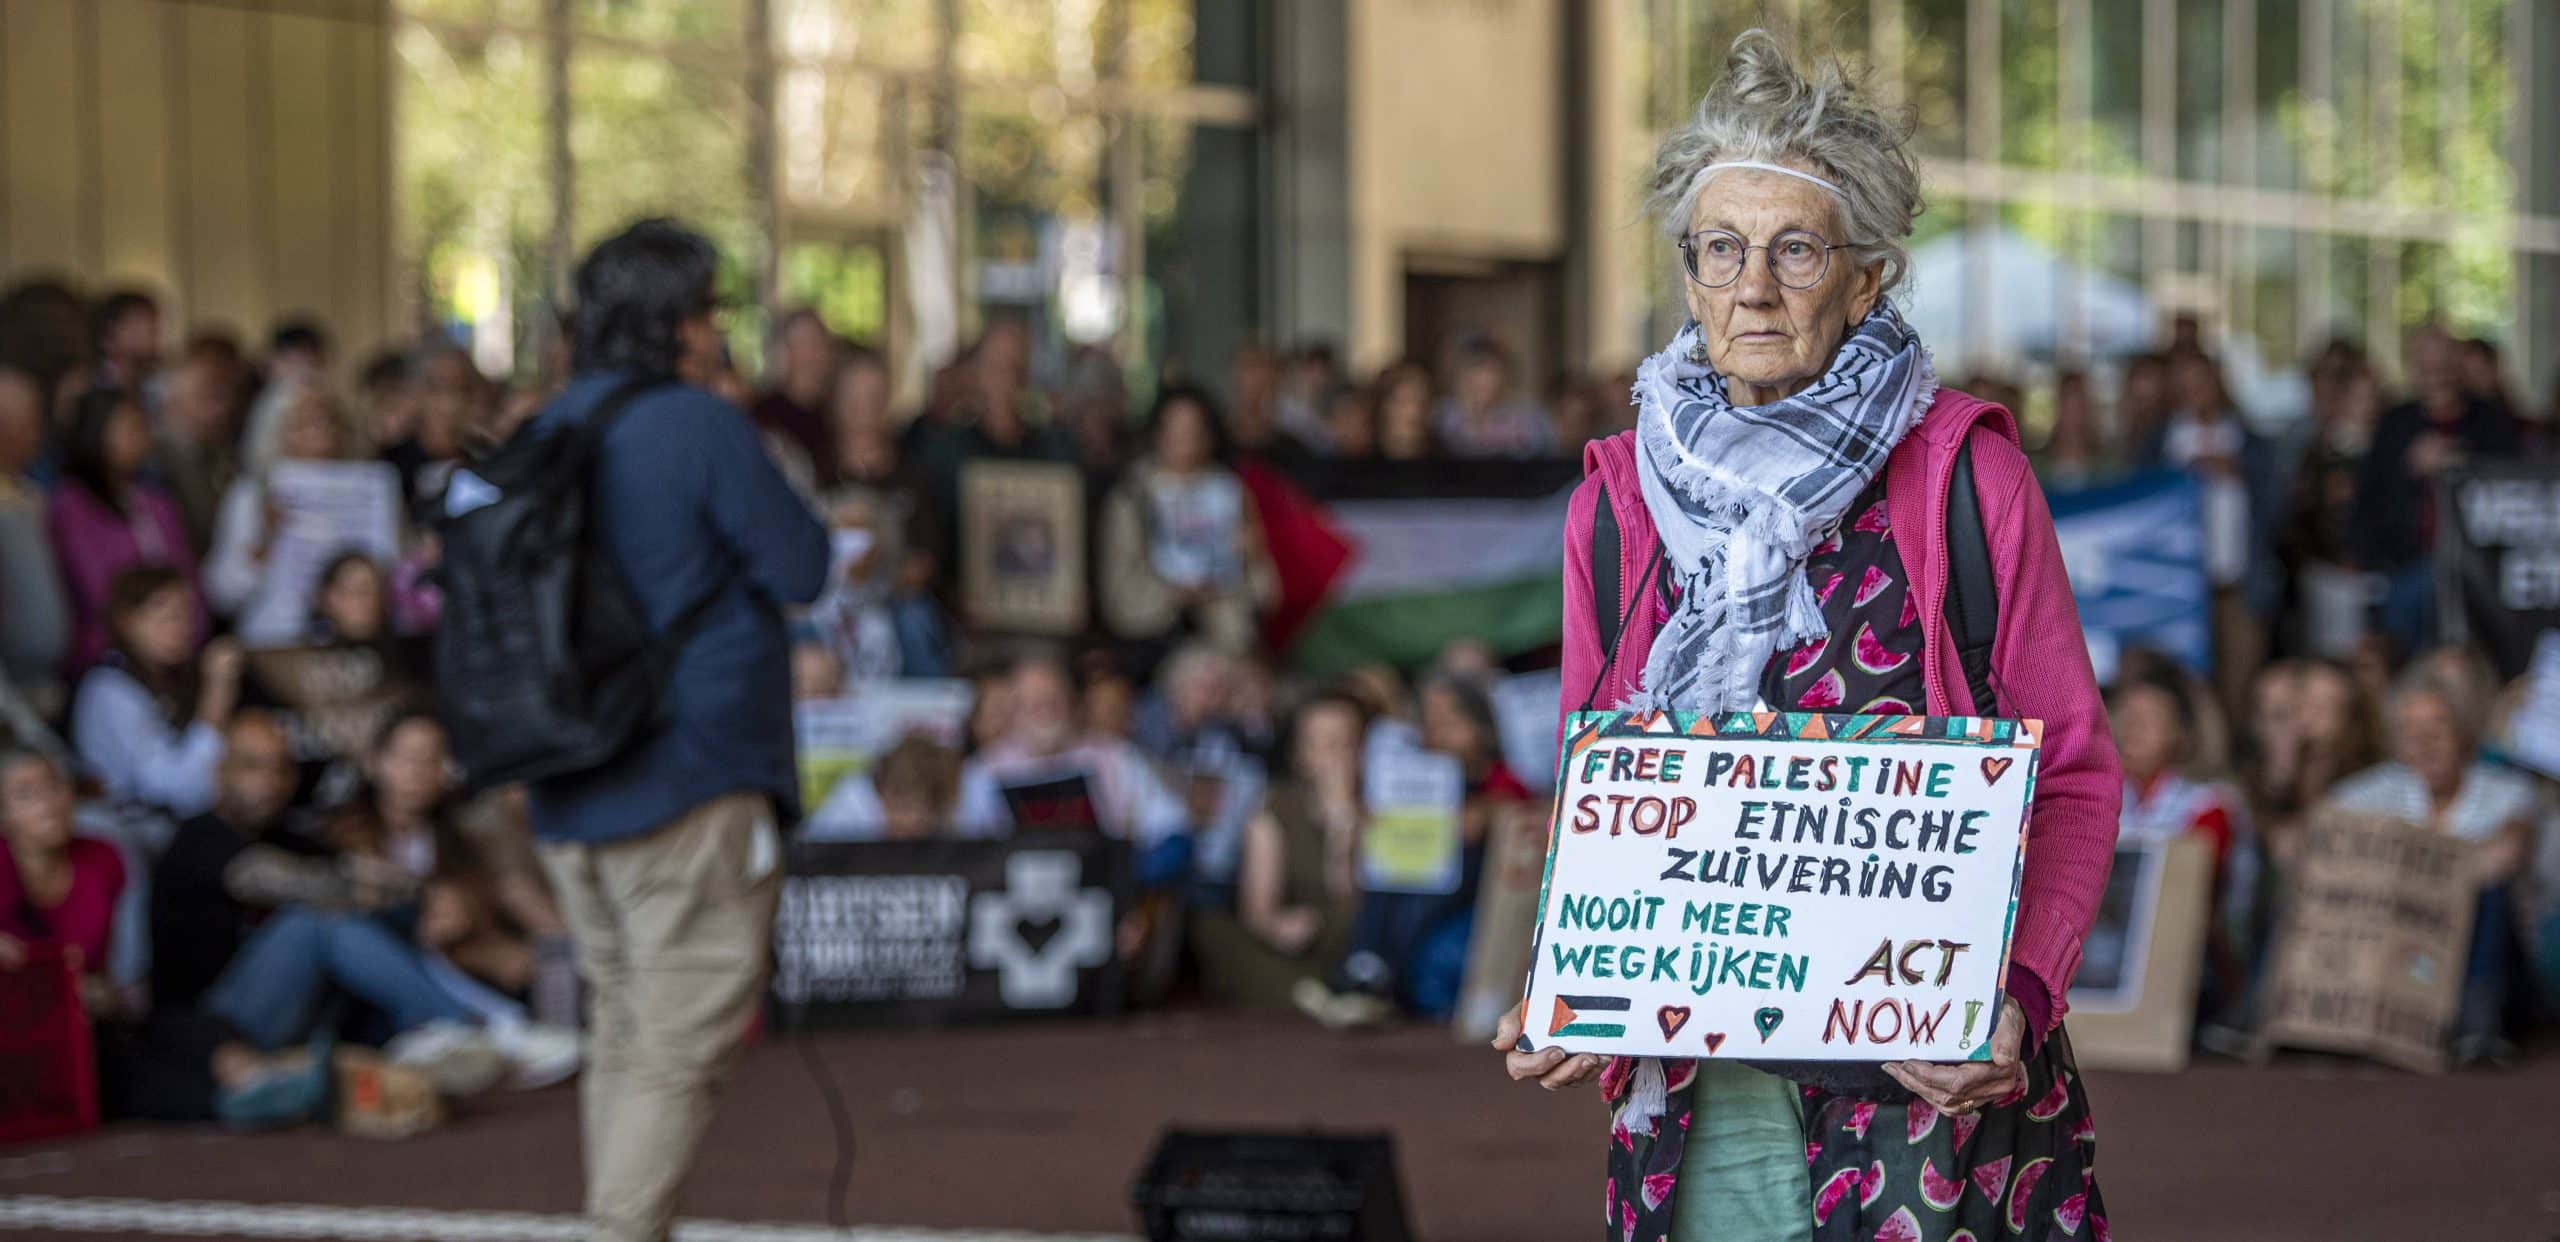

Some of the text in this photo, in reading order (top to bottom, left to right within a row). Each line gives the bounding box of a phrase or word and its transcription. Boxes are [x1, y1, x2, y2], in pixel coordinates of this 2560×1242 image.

[1581, 748, 1956, 798] FREE PALESTINE
[1573, 794, 1697, 839] STOP
[1734, 797, 1990, 854] ETNISCHE
[1660, 846, 1955, 902] ZUIVERING
[1558, 889, 1792, 938] NOOIT MEER
[1551, 942, 1810, 996] WEGKIJKEN
[1844, 938, 1971, 987] ACT
